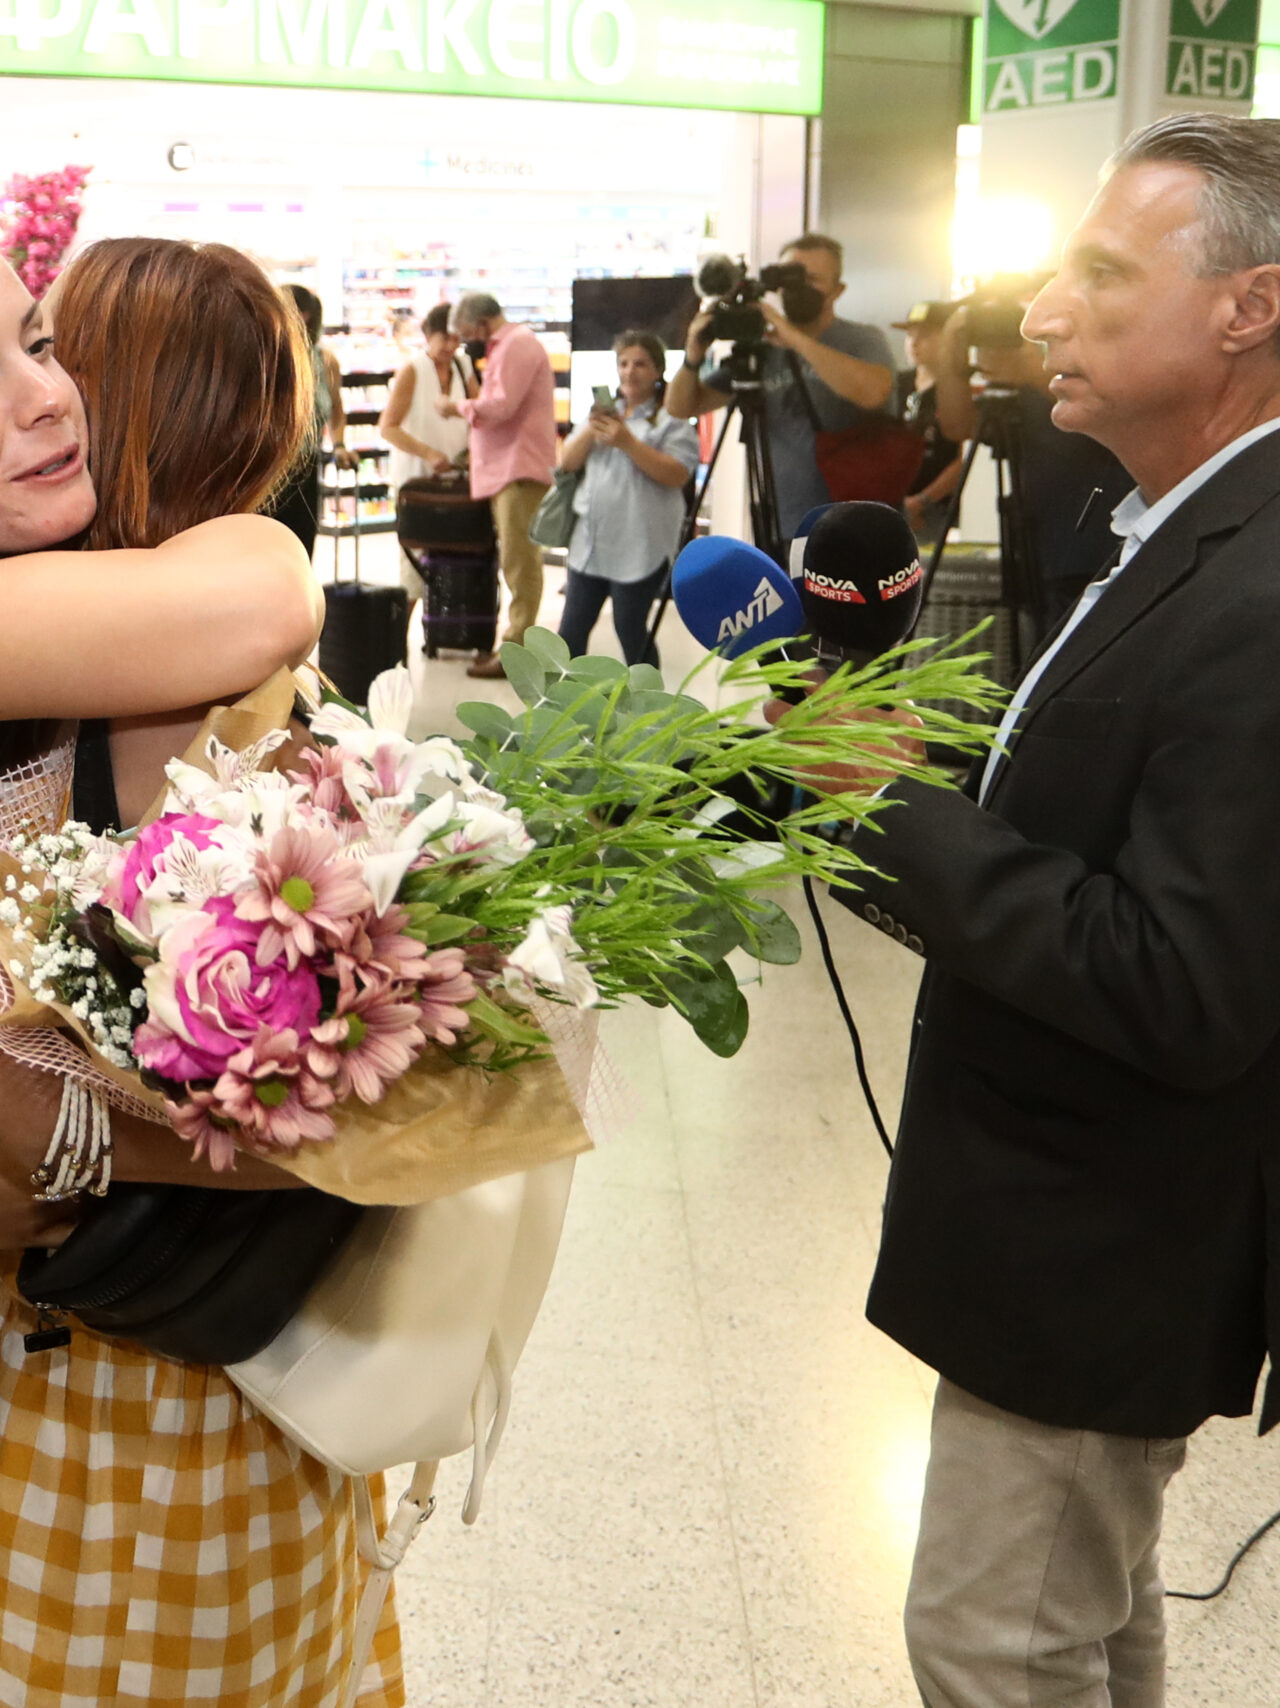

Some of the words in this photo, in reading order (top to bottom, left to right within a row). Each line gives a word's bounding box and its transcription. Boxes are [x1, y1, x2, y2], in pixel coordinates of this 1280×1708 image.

[987, 49, 1115, 110] AED
[1171, 45, 1250, 98] AED
[445, 153, 535, 176] Medicines
[804, 567, 859, 592] NOVA
[877, 558, 920, 590] NOVA
[887, 573, 919, 599] SPORTS
[809, 581, 852, 602] SPORTS
